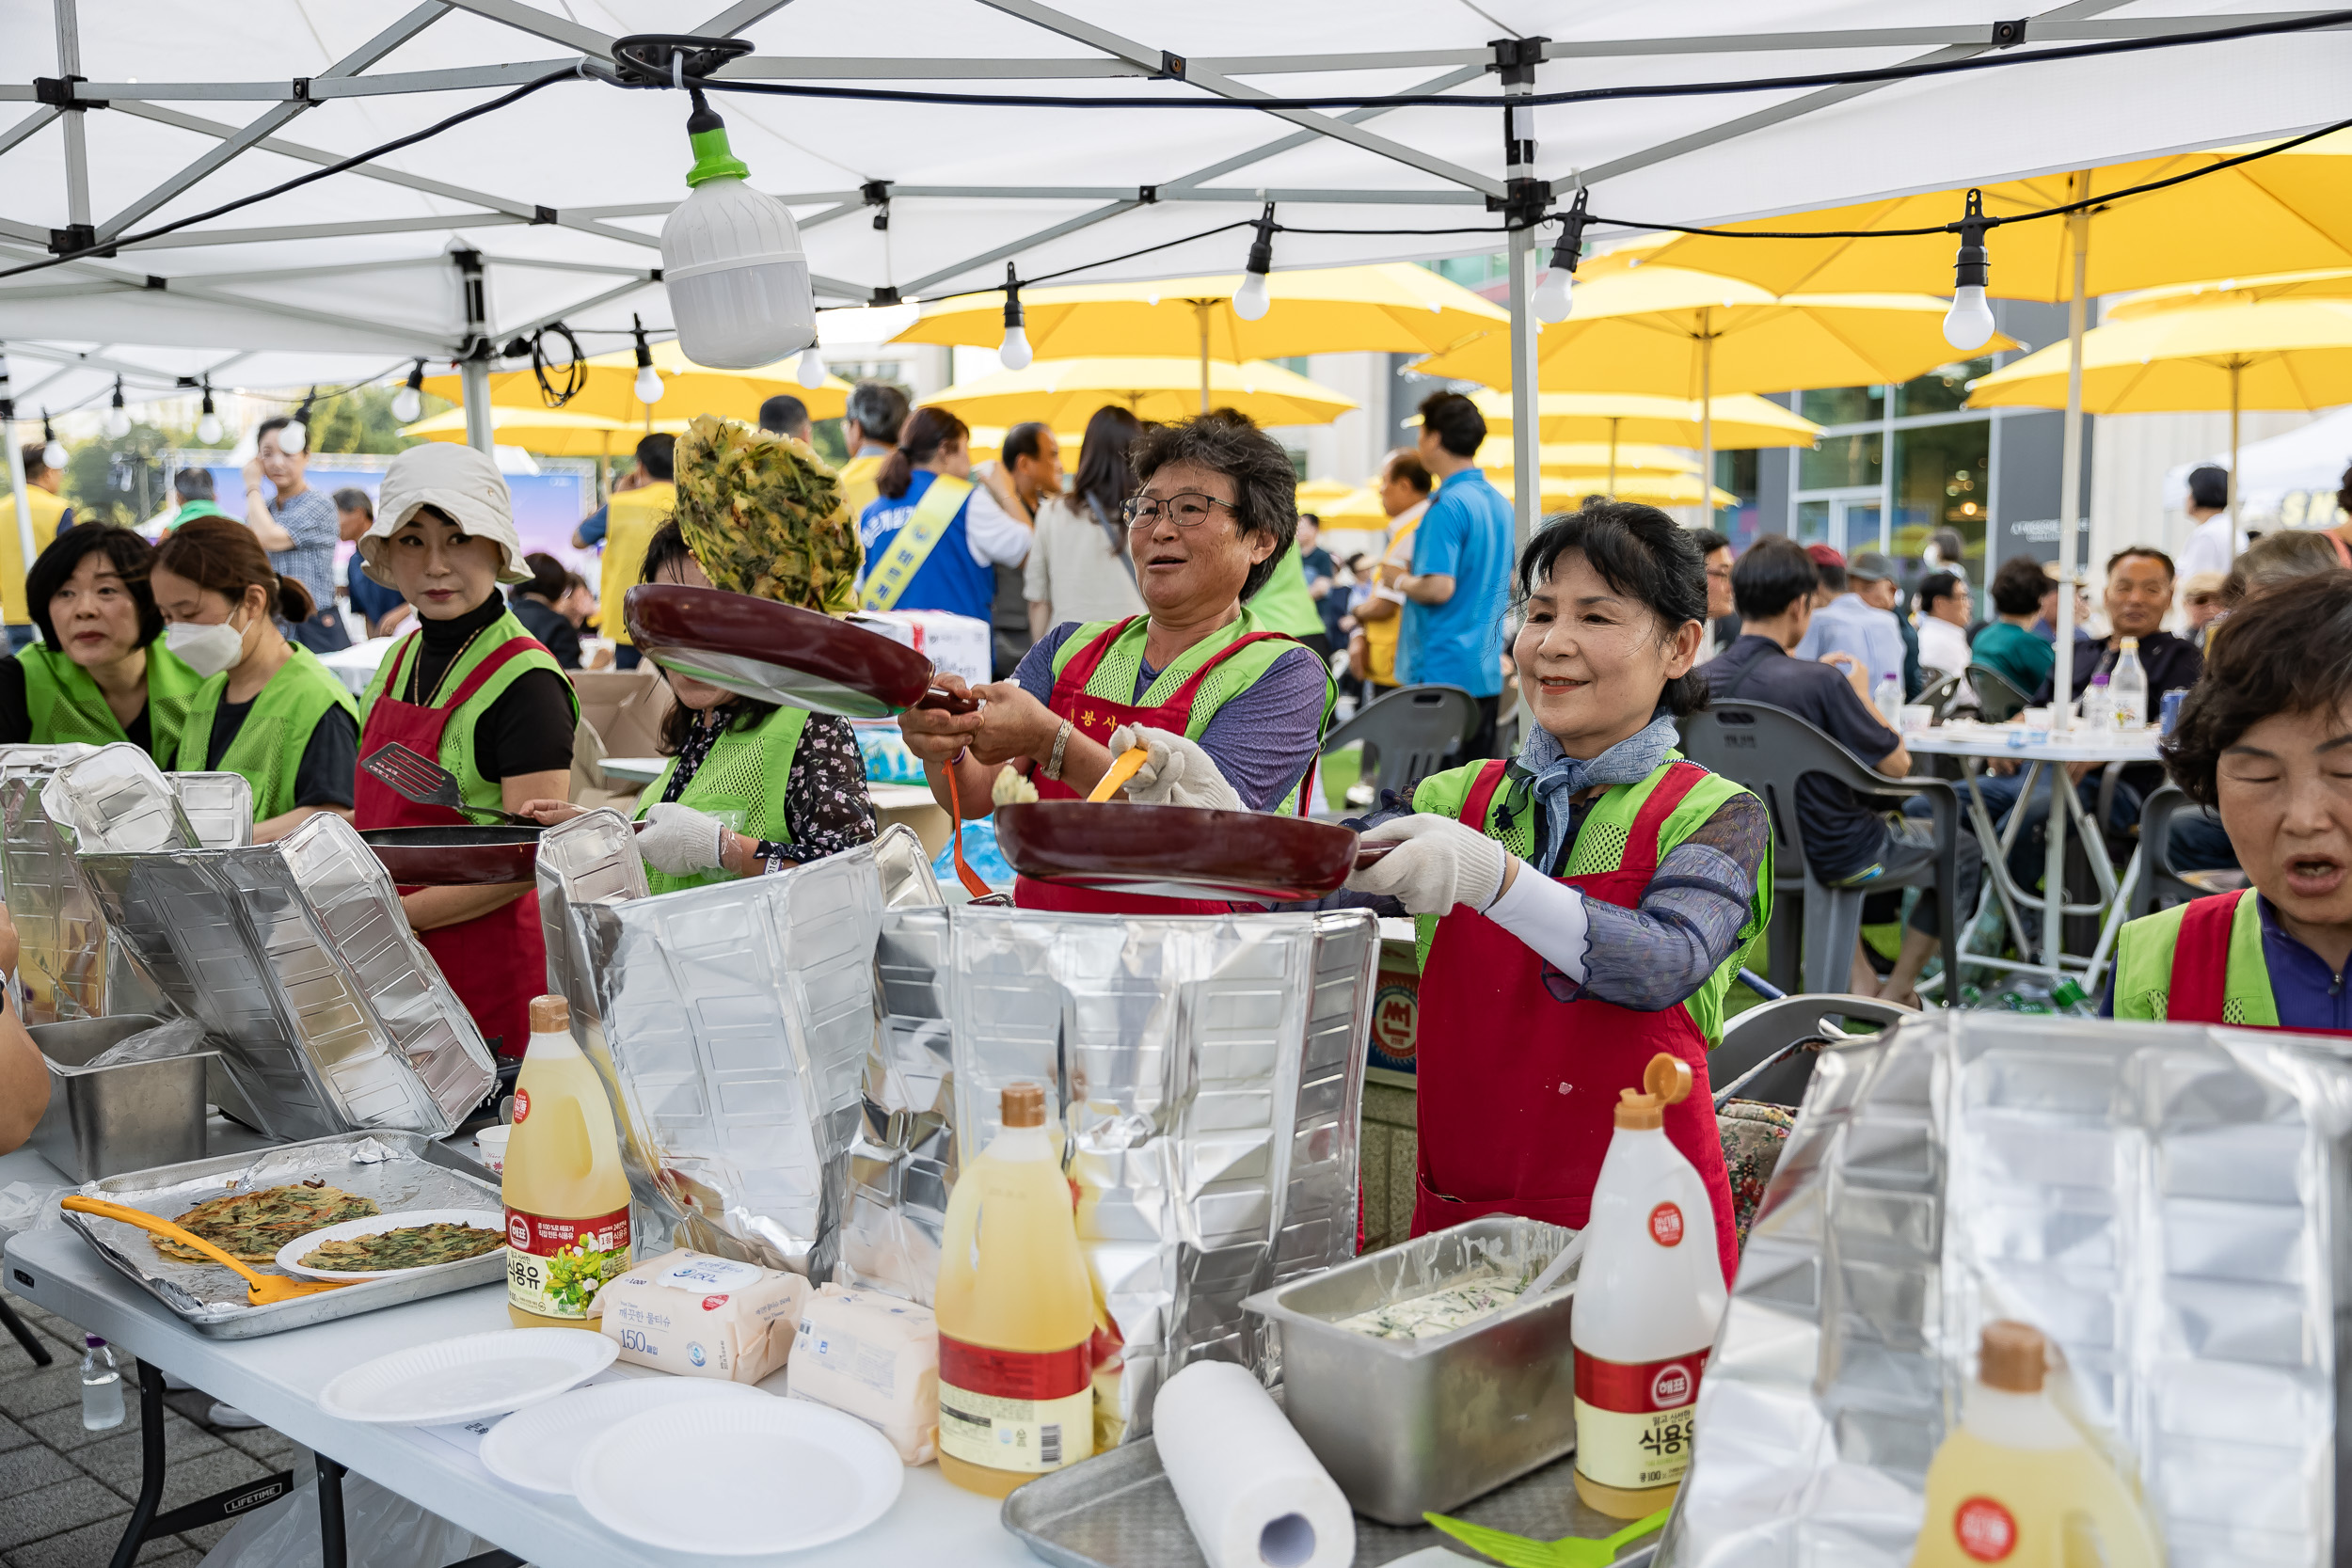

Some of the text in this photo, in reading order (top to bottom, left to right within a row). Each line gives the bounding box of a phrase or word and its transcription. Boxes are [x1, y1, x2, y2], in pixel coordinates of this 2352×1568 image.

[1071, 708, 1118, 732] 봉사
[512, 1225, 527, 1240] 해표
[559, 1232, 574, 1241] 식용유
[601, 1235, 612, 1245] 1등
[613, 1227, 628, 1241] 식용유
[507, 1257, 541, 1290] 식용유
[619, 1307, 671, 1328] 깨끗한 물티슈
[1659, 1378, 1685, 1394] 해표
[1652, 1409, 1691, 1426] 맑고 신선한
[231, 1487, 276, 1510] LIFETIME
